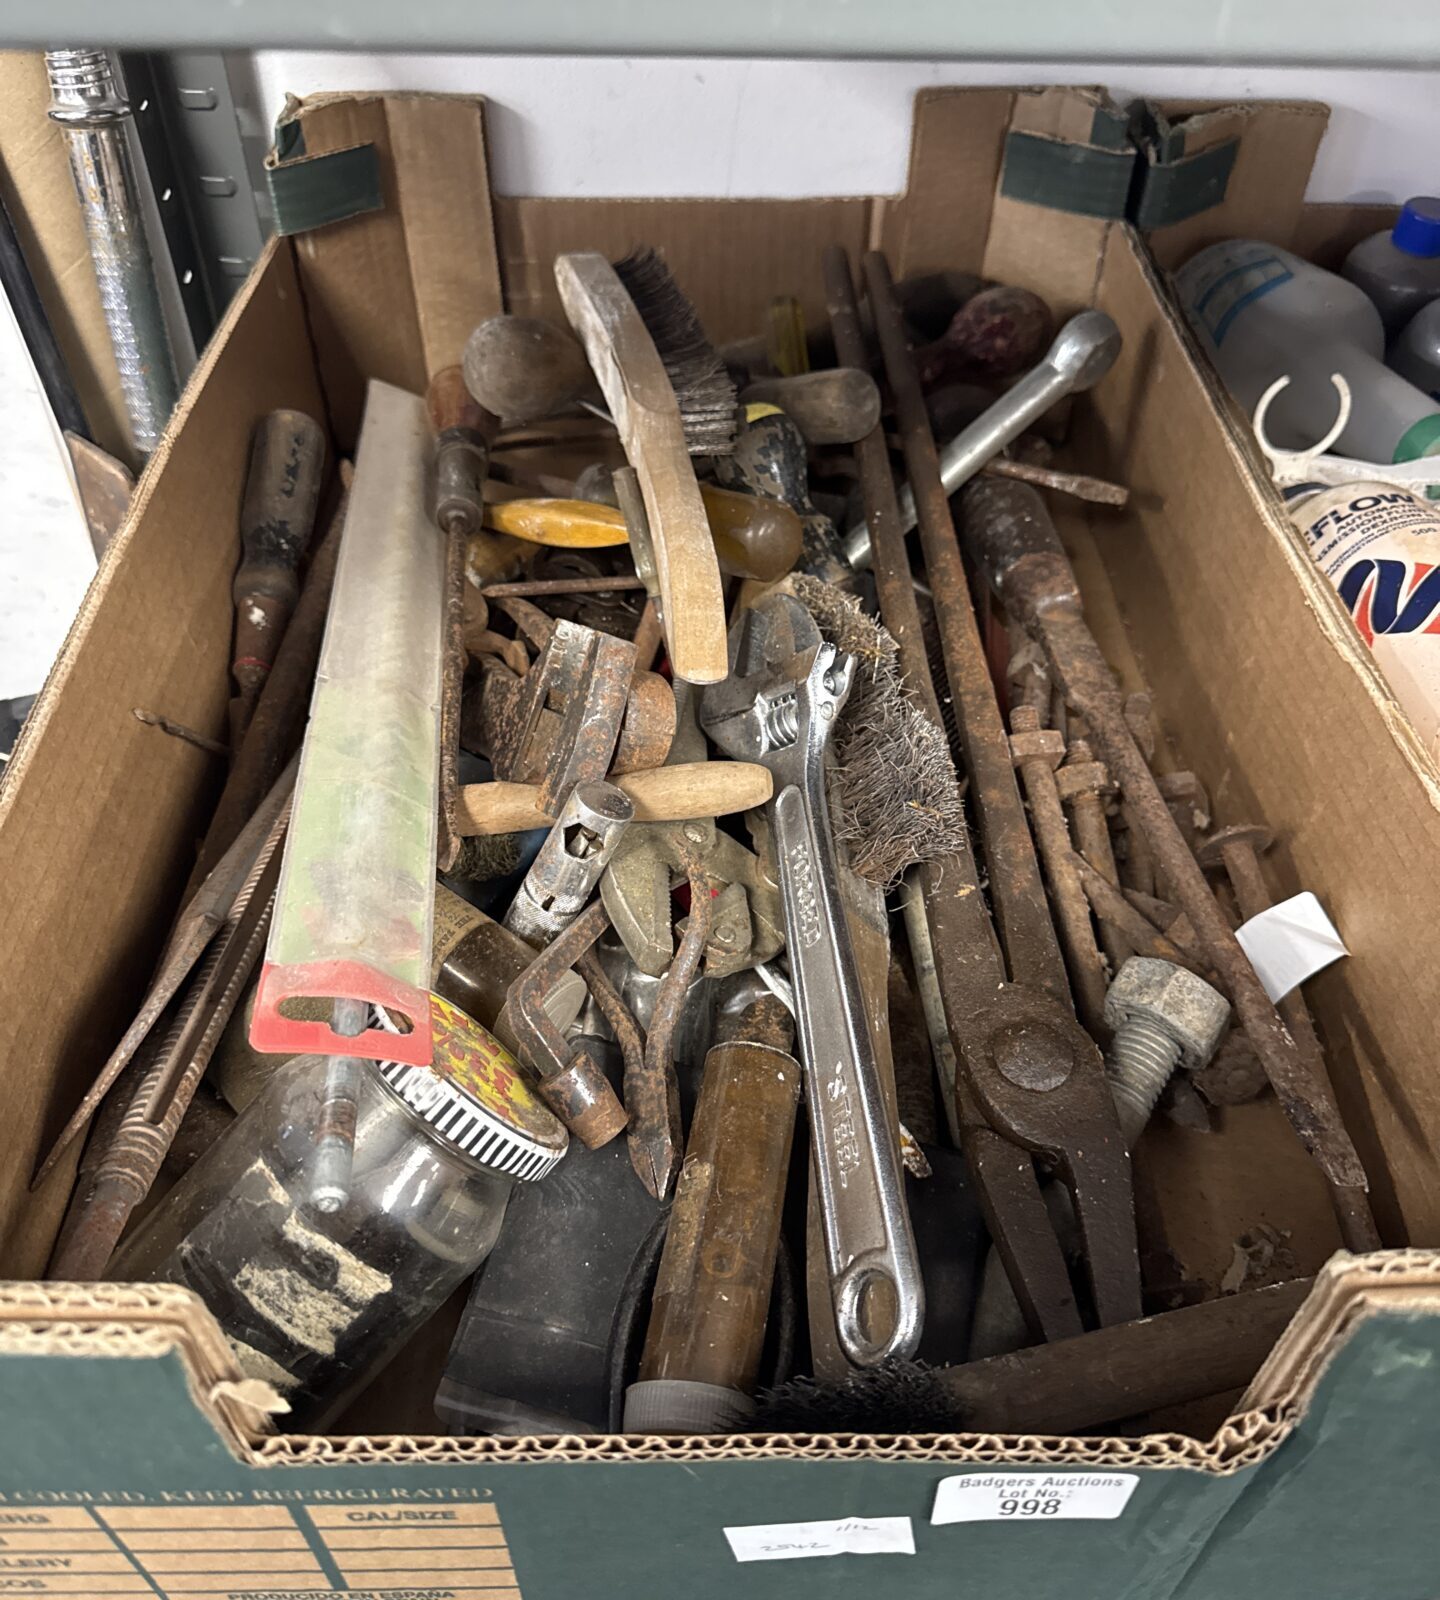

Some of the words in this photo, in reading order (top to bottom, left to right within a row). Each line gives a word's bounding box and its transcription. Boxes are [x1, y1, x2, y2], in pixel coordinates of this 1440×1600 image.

[1361, 513, 1422, 535] DEXRON
[959, 1477, 1036, 1489] Badgers
[1042, 1476, 1125, 1487] Auctions
[160, 1489, 244, 1501] KEEP
[251, 1486, 494, 1500] REFRIGERATED
[998, 1488, 1028, 1498] Lot
[998, 1499, 1062, 1516] 998
[346, 1510, 458, 1522] CAL/SIZE
[0, 1558, 72, 1568] LERY
[228, 1592, 344, 1600] PRODUCIDO
[348, 1591, 373, 1600] EN
